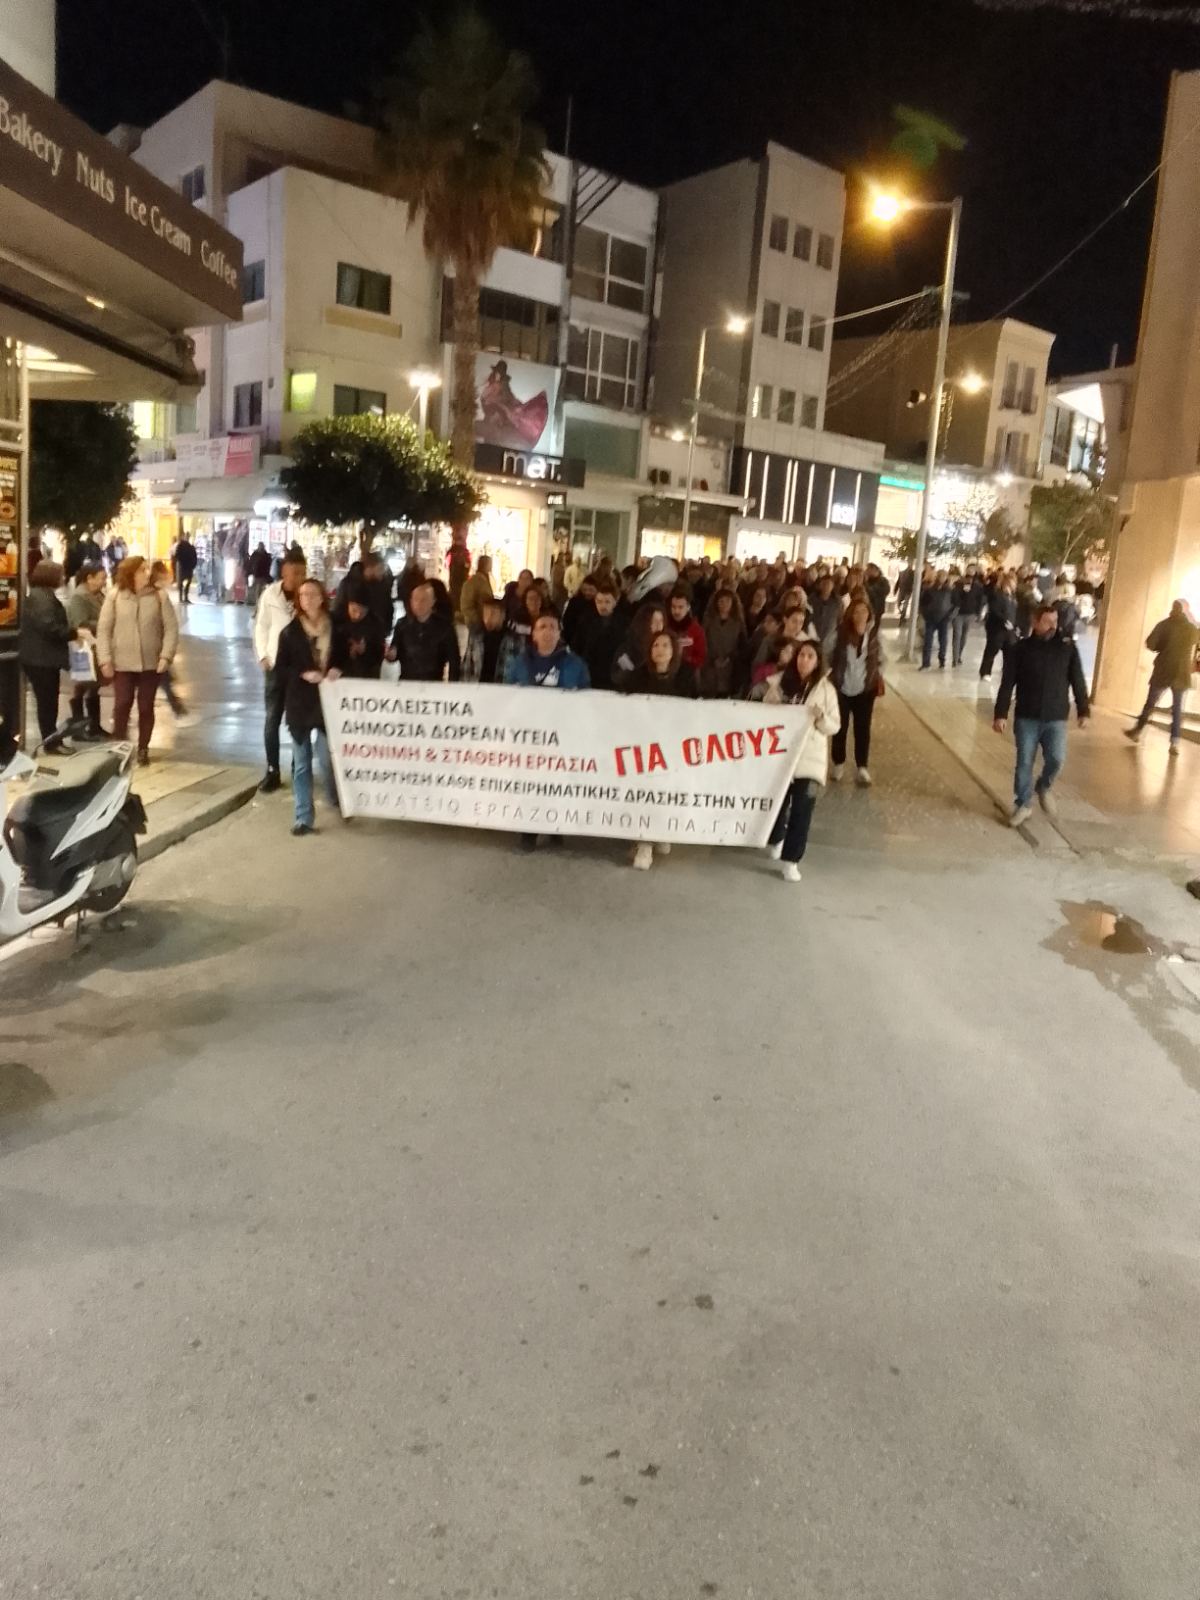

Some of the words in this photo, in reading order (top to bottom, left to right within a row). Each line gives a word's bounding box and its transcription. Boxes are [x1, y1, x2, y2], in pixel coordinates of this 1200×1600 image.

[0, 96, 63, 176] Bakery
[76, 150, 116, 204] Nuts
[124, 185, 147, 226] Ice
[150, 204, 192, 256] Cream
[200, 239, 238, 290] Coffee
[340, 696, 474, 717] ΑΠΟΚΛΕΙΣΤΙΚΑ
[341, 719, 427, 738] ΔΗΜΟΣΙΑ
[431, 724, 506, 743] ΔΩΡΕΑΝ
[511, 728, 559, 747] ΥΓΕΙΑ
[341, 742, 421, 763] ΜΟΝΙΜΗ
[425, 747, 437, 764] &
[442, 748, 521, 769] ΣΤΑΘΕΡΗ
[526, 753, 598, 774] ΕΡΓΑΣΙΑ
[614, 742, 668, 778] ΓΙΑ
[681, 724, 788, 768] ΟΛΟΥΣ
[343, 768, 433, 787] ΚΑΤΑΡΓΗΣΗ
[435, 773, 476, 790] ΚΑΘΕ
[479, 778, 621, 801] ΕΠΙΧΕΙΡΗΜΑΤΙΚΗΣ
[624, 791, 690, 807] ΔΡΑΣΗΣ
[693, 793, 736, 809] ΣΤΗΝ
[473, 802, 651, 829] ΕΡΓΑΖΟΜΕΝΩΝ
